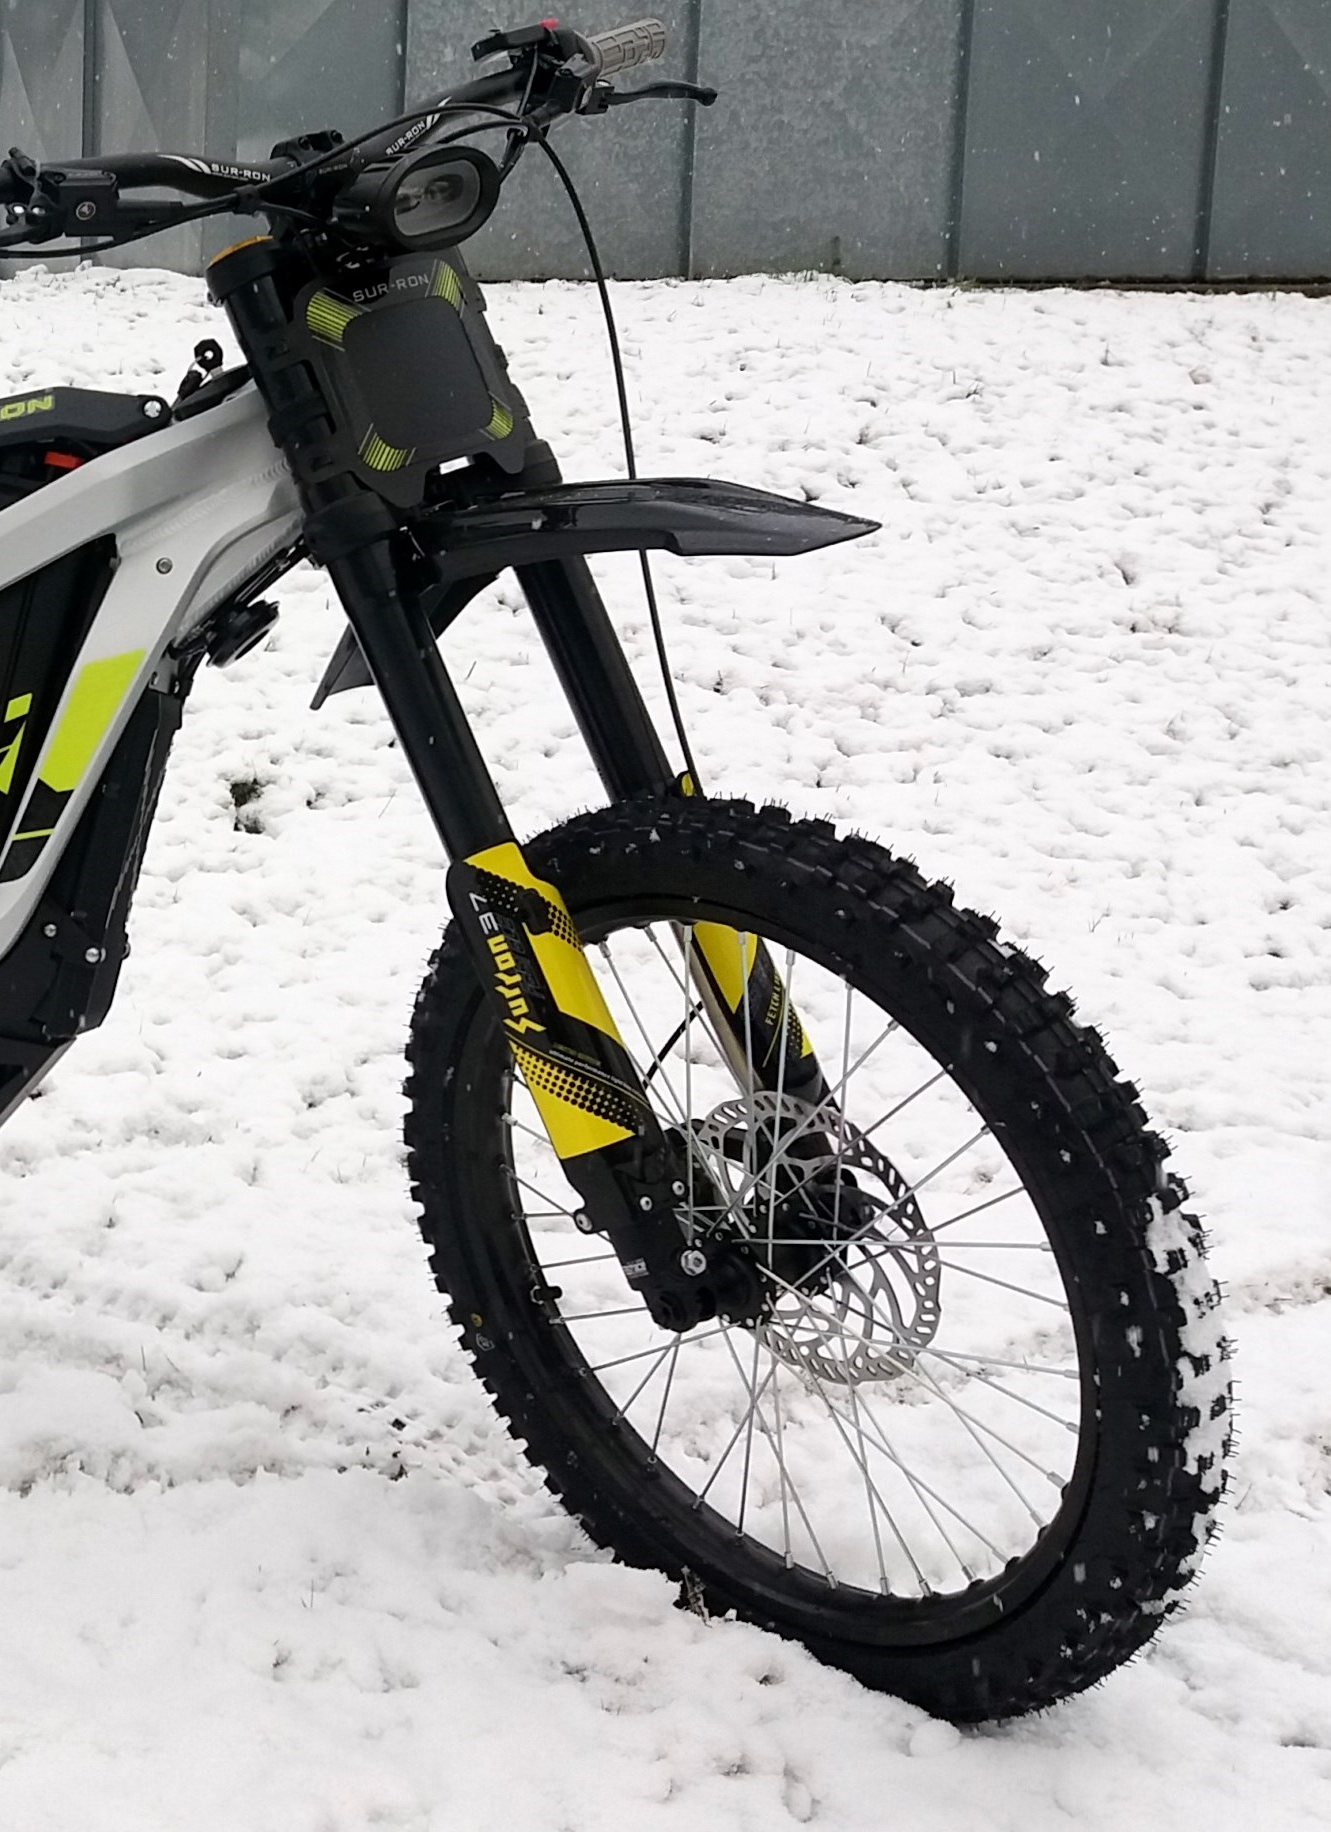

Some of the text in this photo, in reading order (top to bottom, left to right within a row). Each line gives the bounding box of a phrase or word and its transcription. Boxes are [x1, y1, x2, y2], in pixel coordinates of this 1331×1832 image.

[385, 120, 426, 156] SUR-RON
[210, 162, 271, 182] SUR-RON
[352, 273, 430, 303] SUR-RON
